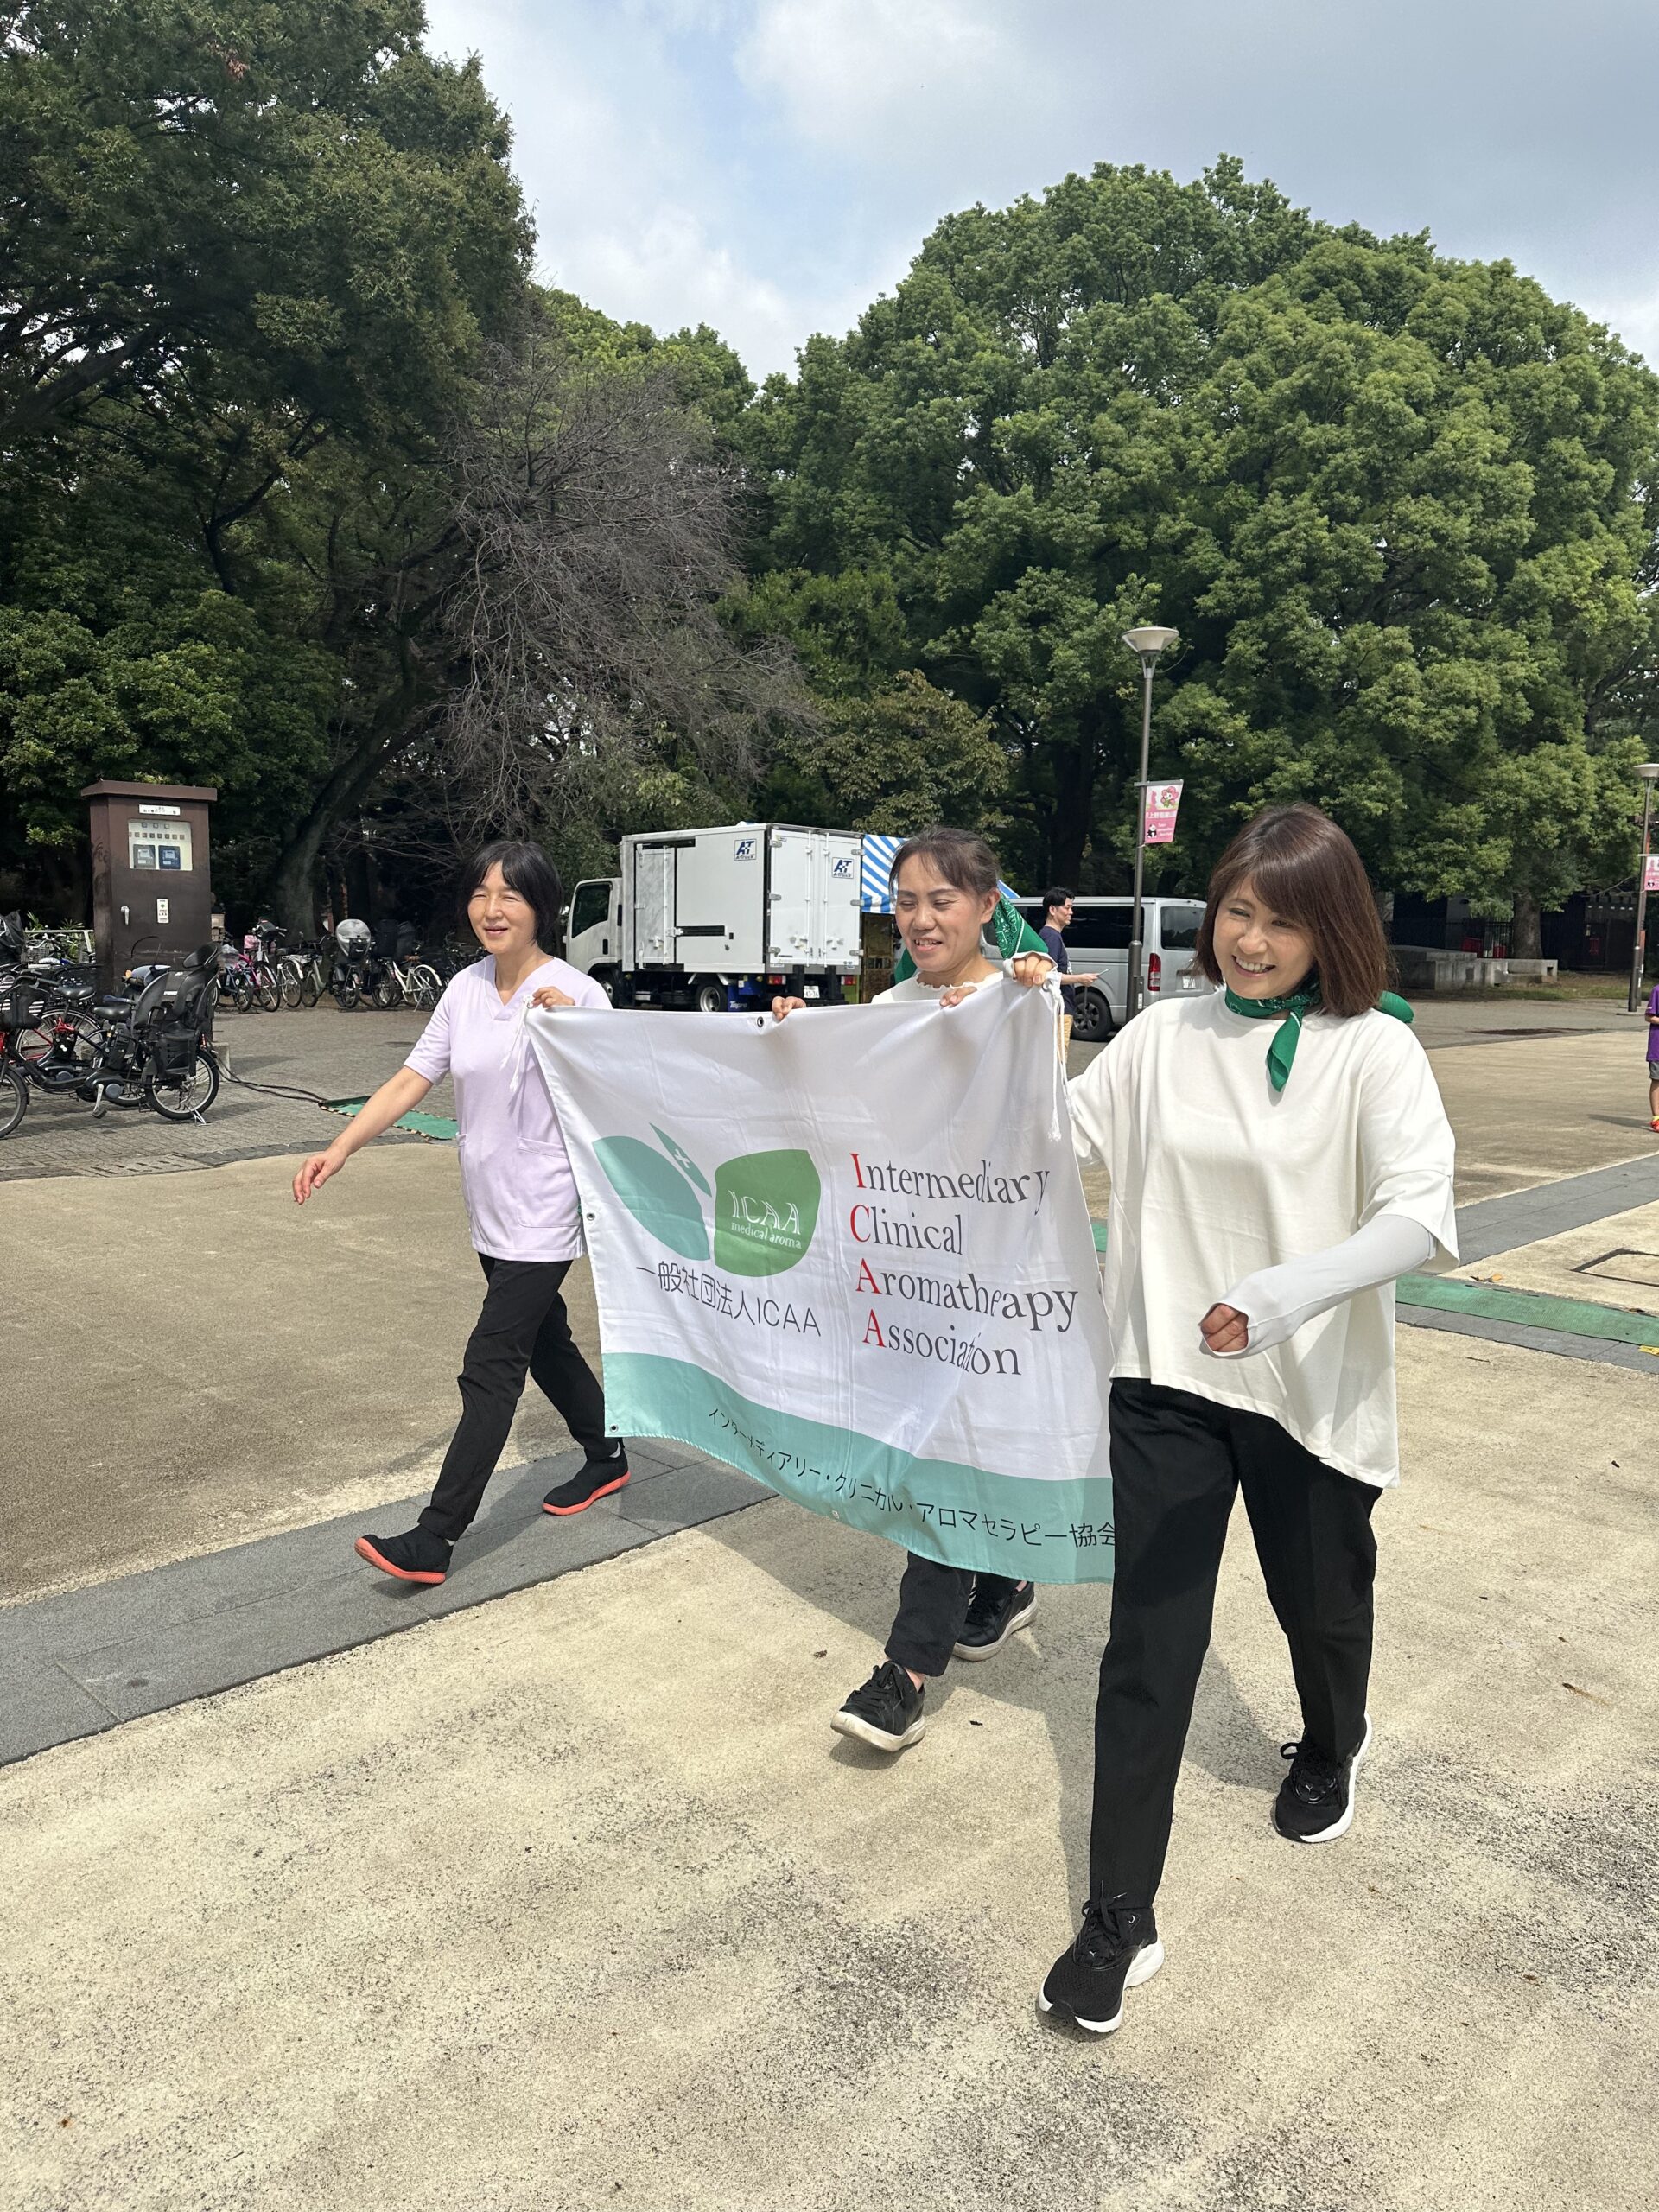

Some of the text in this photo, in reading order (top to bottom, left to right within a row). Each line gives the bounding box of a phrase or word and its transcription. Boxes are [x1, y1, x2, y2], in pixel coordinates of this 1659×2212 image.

[728, 1189, 802, 1236] ICAA
[849, 1153, 1051, 1216] Intermediary
[731, 1221, 803, 1249] medical aroma
[849, 1204, 963, 1256] Clinical
[635, 1260, 822, 1338] 一般社団法人ICAA
[855, 1257, 1079, 1333] Aromatheapy
[861, 1308, 1022, 1376] Association
